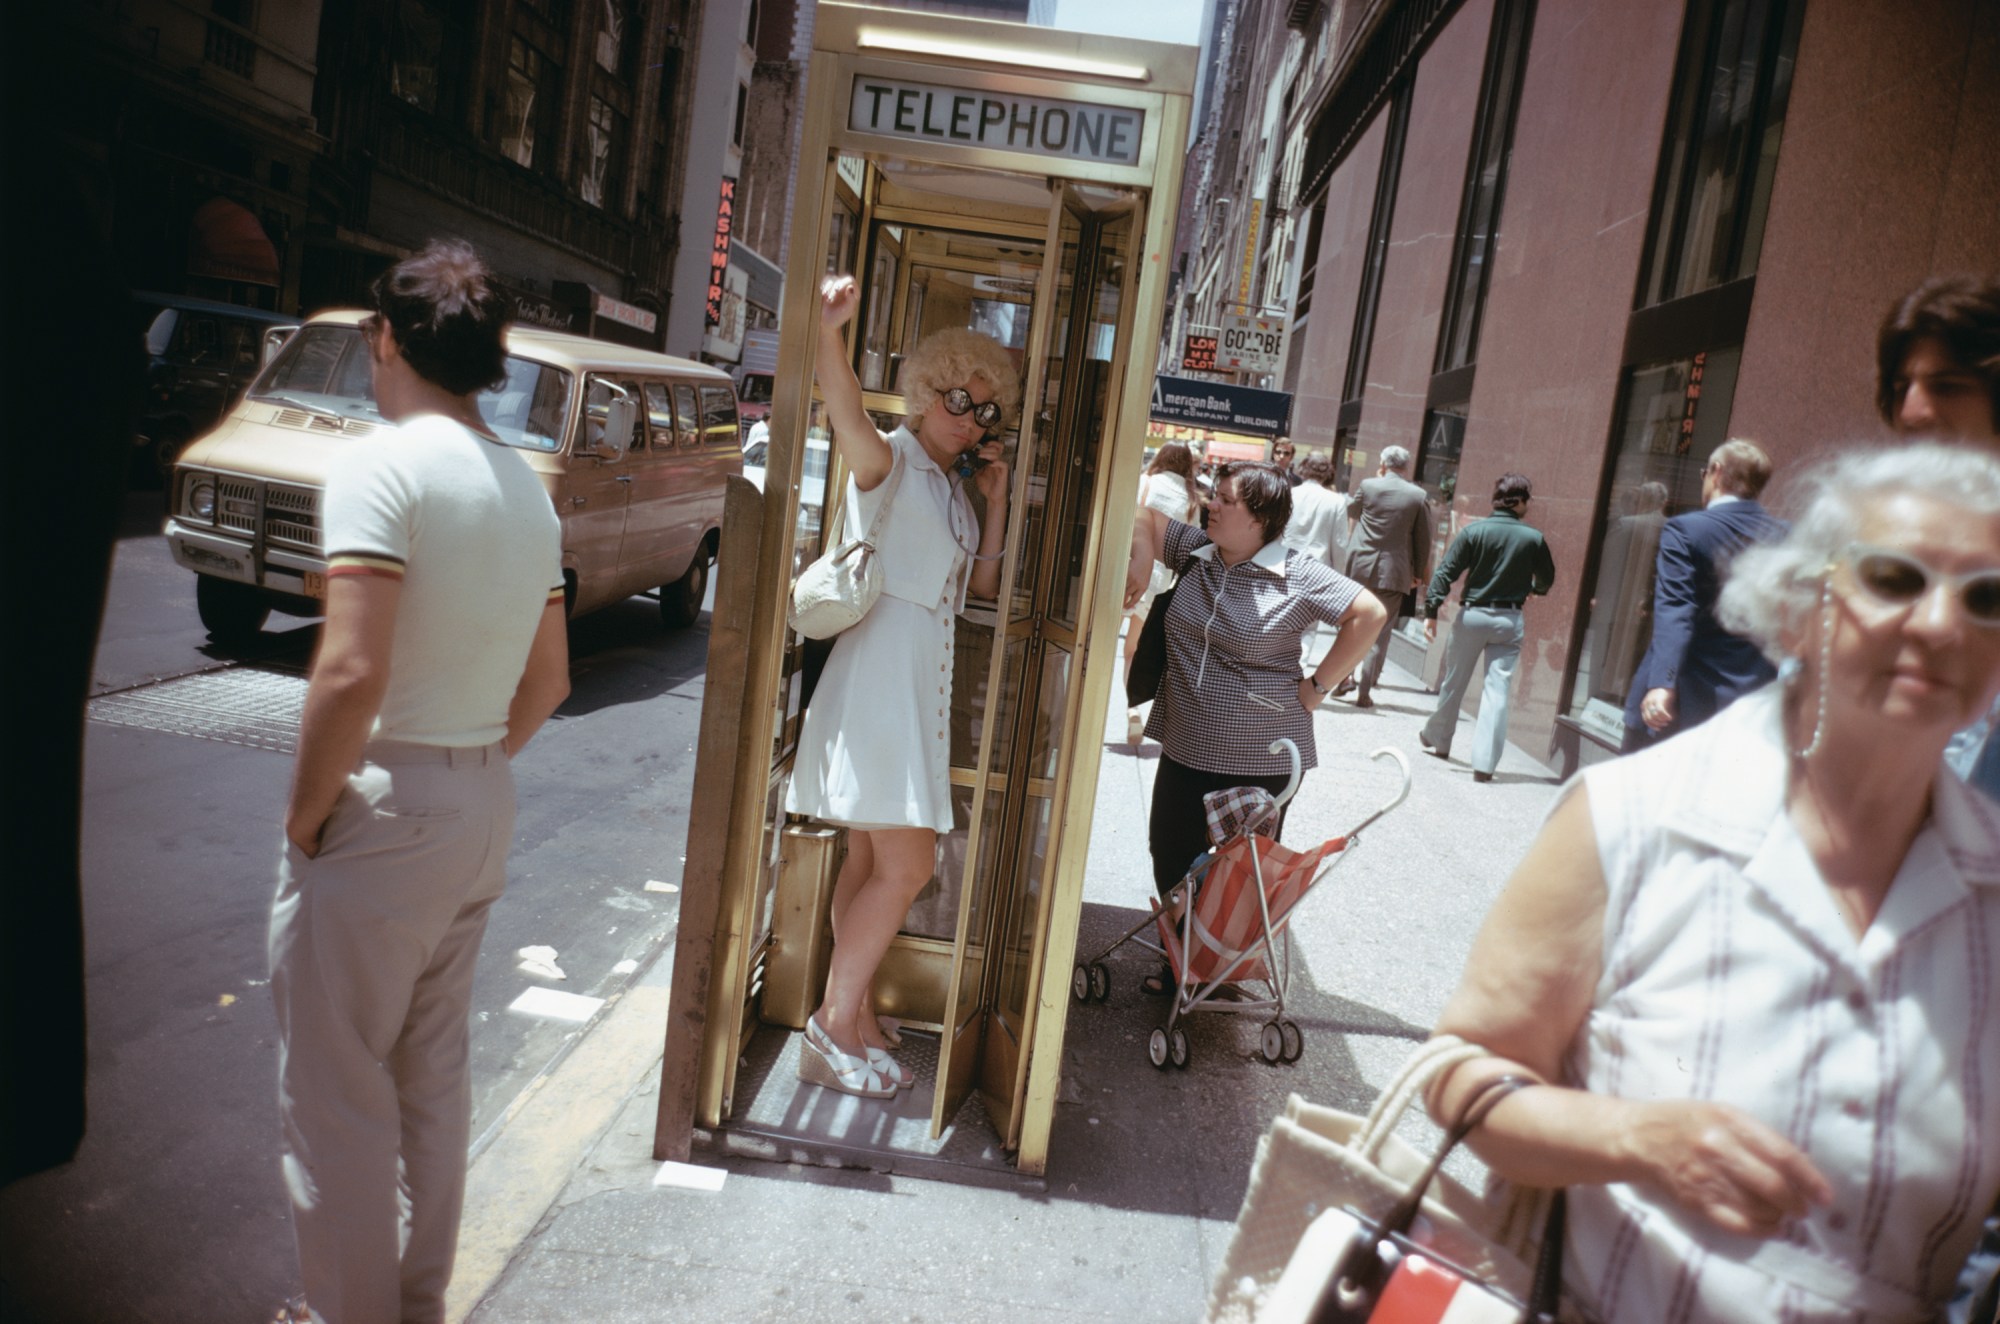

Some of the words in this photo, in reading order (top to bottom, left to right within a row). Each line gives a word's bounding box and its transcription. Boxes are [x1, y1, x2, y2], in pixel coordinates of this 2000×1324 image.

[864, 85, 1133, 160] TELEPHONE
[708, 181, 735, 301] KASHMIR
[1225, 349, 1260, 361] MARINE
[1152, 403, 1181, 415] TRUST
[1183, 407, 1230, 421] COMPANY
[1234, 414, 1278, 429] BUILDING
[1207, 395, 1232, 413] Bank
